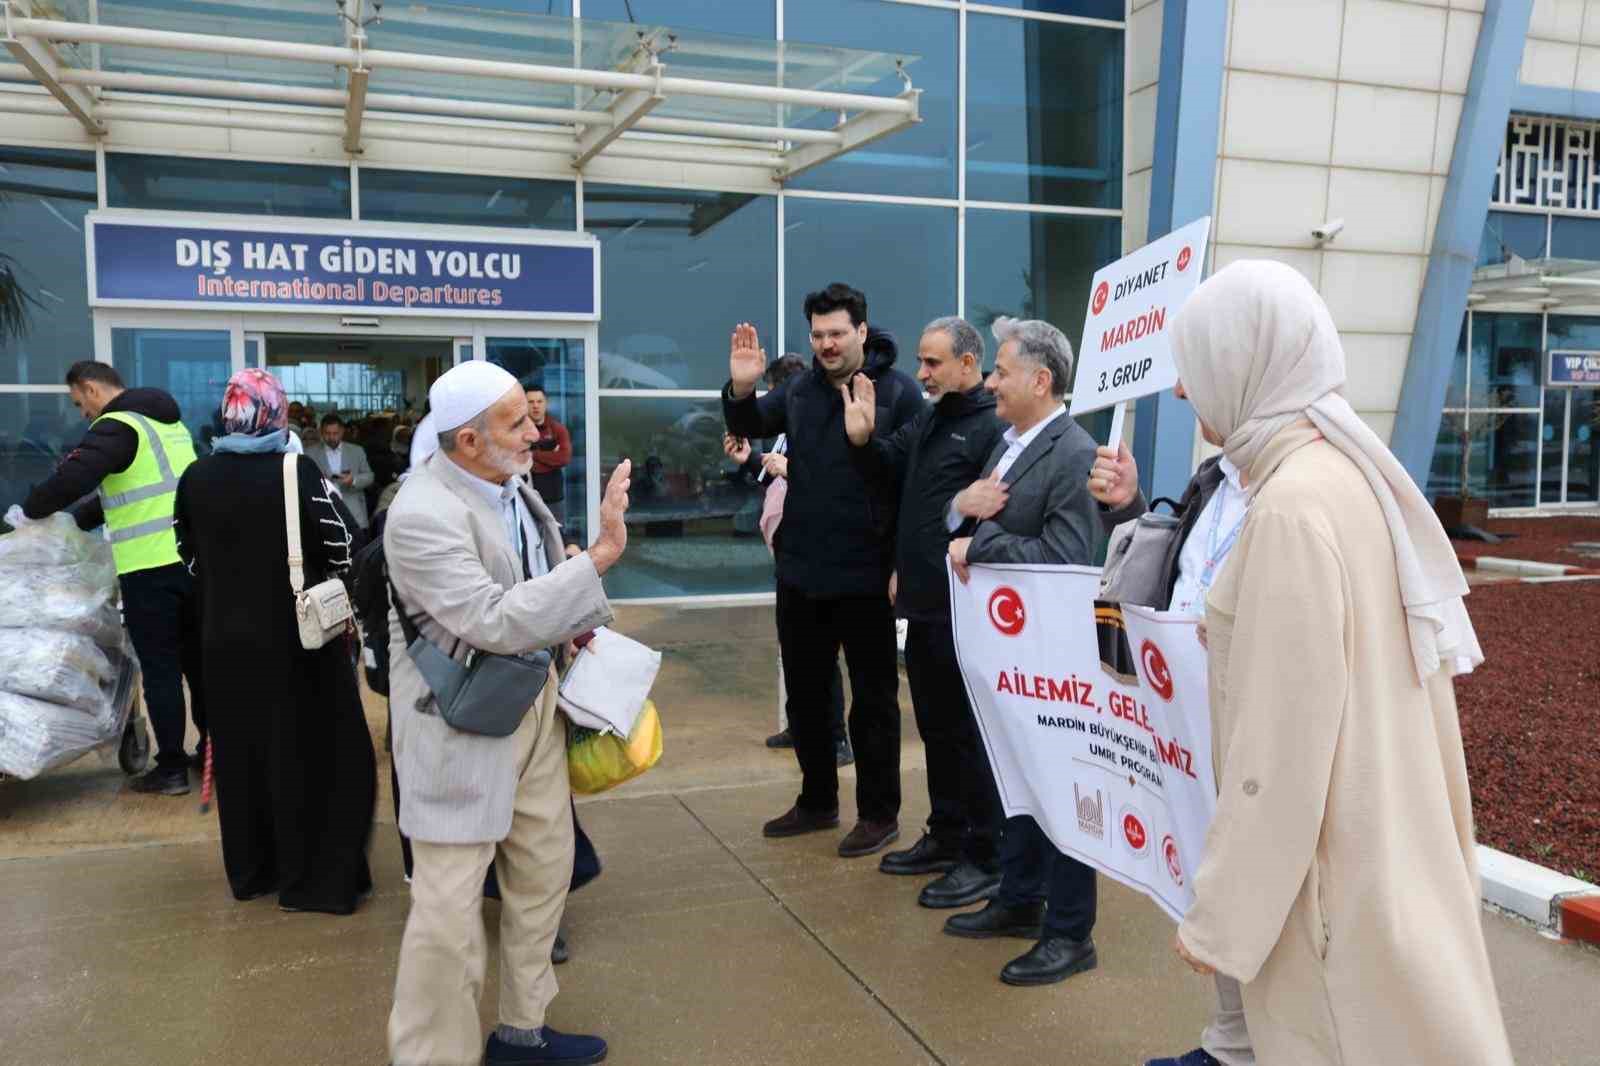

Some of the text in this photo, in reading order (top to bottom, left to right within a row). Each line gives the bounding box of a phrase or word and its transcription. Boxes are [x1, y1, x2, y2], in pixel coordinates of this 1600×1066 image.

[176, 238, 521, 279] DIŞ HAT GİDEN YOLCU
[198, 274, 503, 306] International Departures
[1114, 261, 1169, 301] DİYANET
[1100, 305, 1166, 352] MARDİN
[1098, 358, 1152, 392] 3. GRUP
[1565, 357, 1582, 369] VIP
[997, 666, 1102, 714] AİLEMİZ,
[1037, 714, 1086, 732] MARDİN
[1090, 743, 1118, 764] UMRE
